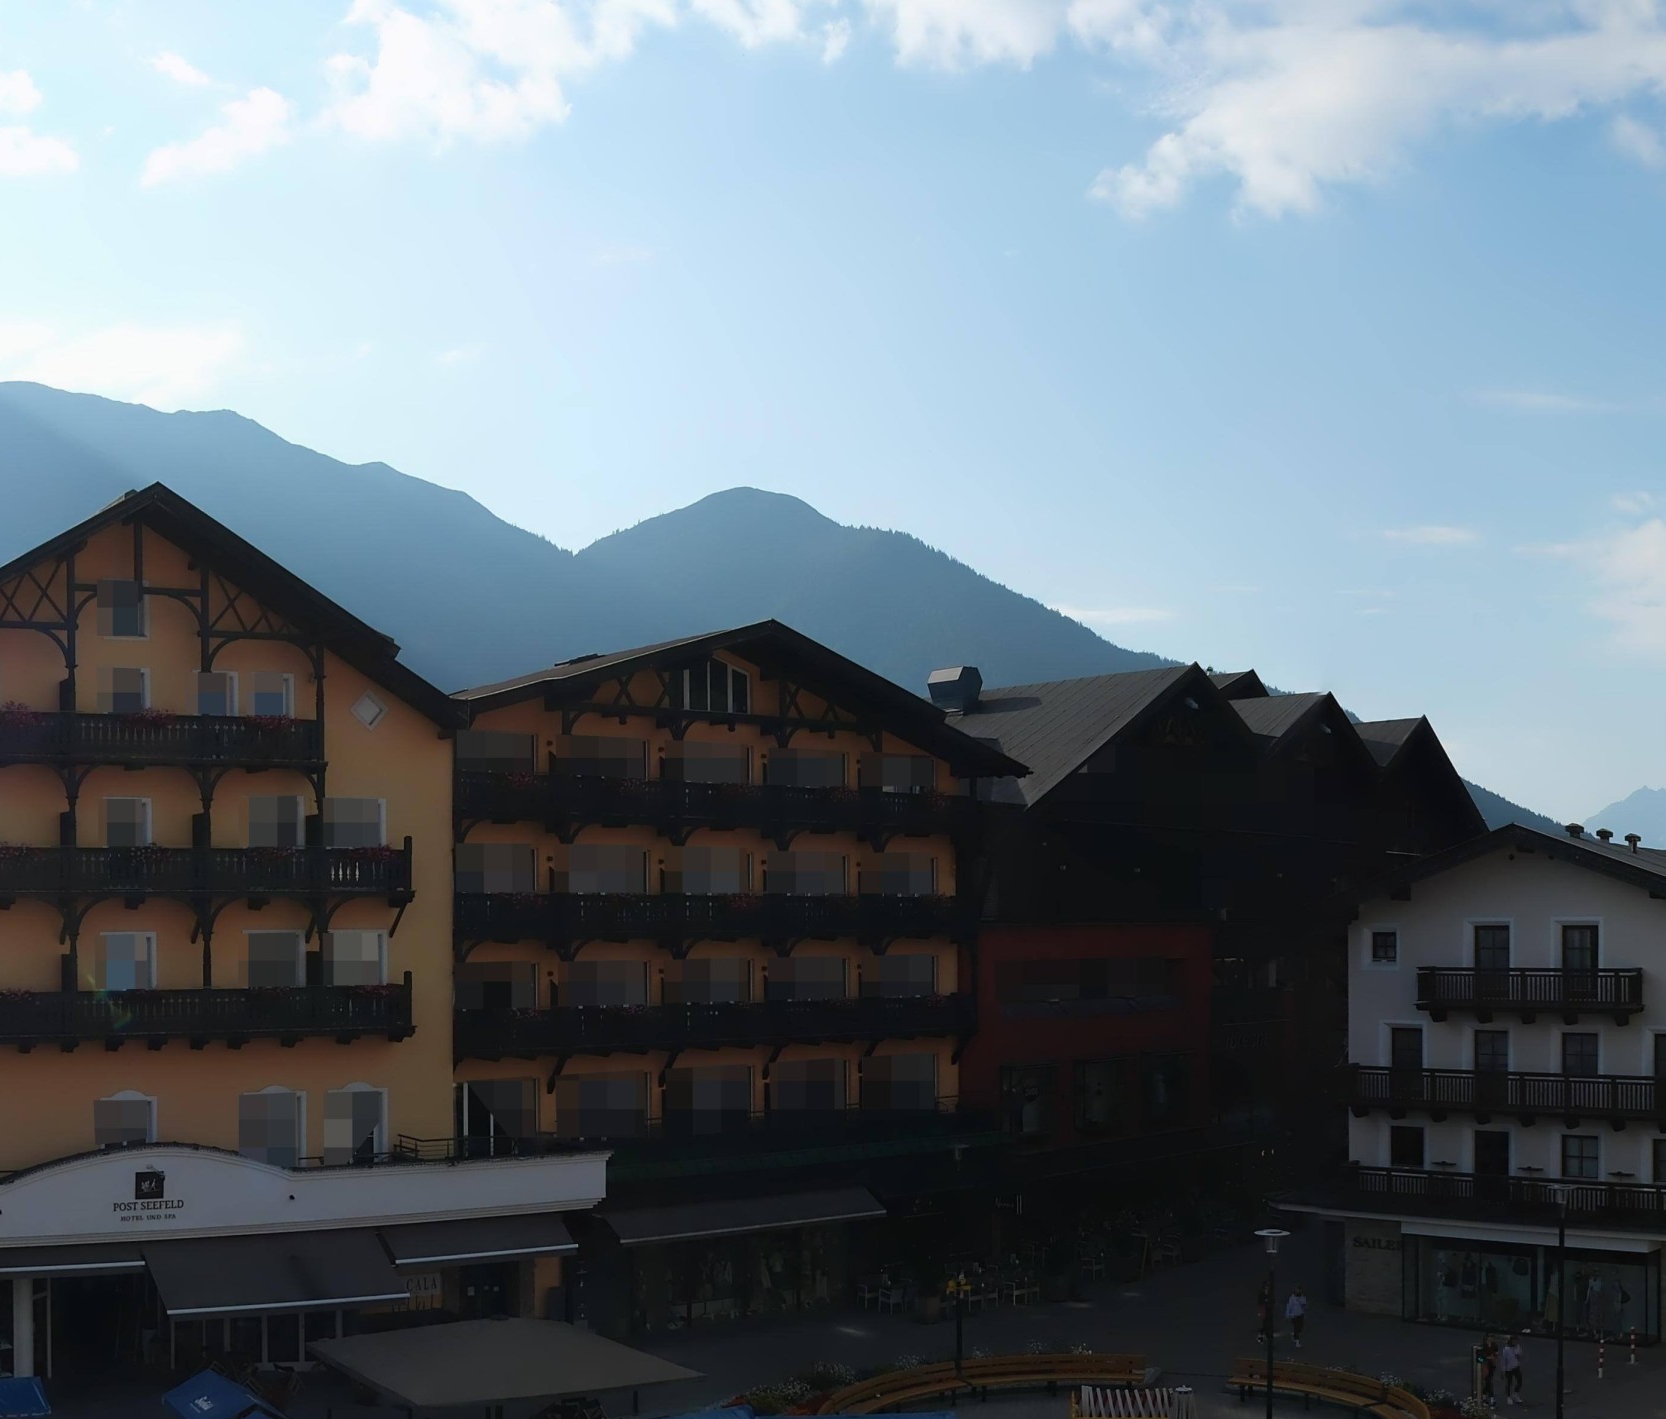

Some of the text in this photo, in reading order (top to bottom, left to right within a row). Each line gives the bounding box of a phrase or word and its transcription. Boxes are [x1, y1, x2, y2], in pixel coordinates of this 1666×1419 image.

[113, 1199, 184, 1213] POST SEEFELD
[120, 1214, 144, 1222] HOTEL
